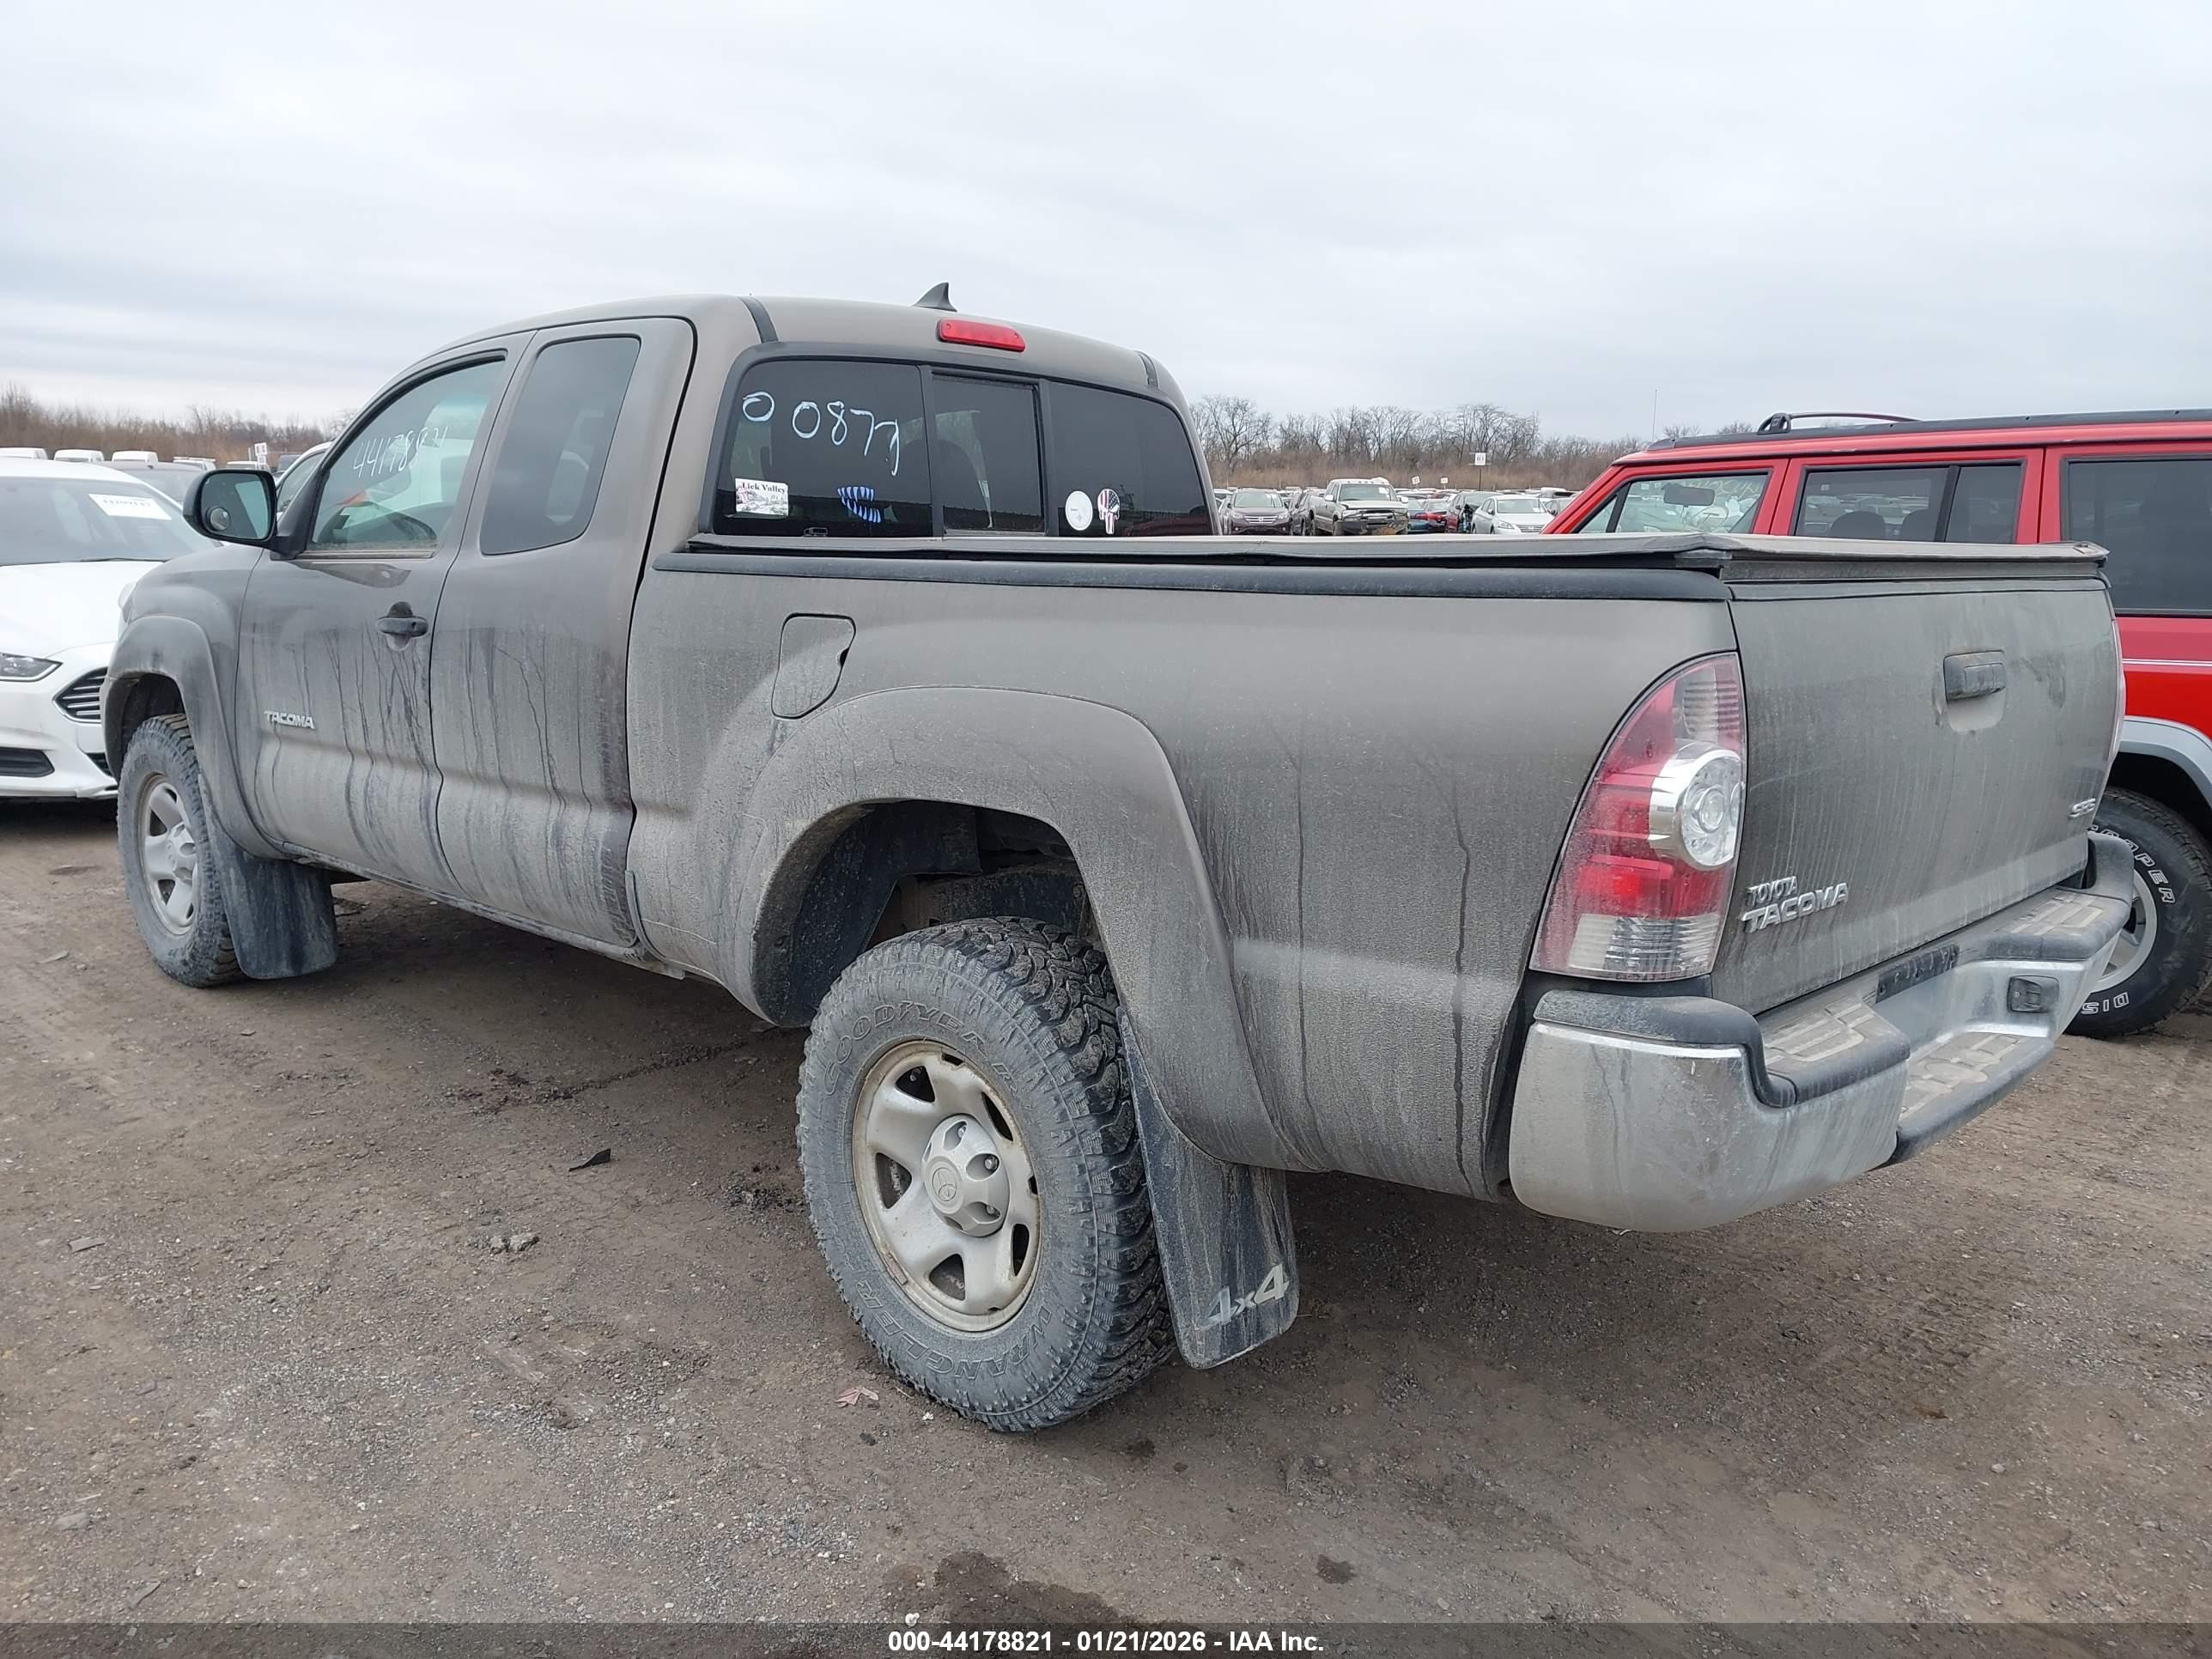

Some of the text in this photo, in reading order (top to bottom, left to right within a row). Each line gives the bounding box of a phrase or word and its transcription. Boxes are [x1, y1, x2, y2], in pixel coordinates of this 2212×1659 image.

[762, 484, 786, 494] Valley
[264, 710, 315, 730] TACOMA
[1741, 883, 1849, 933] TACOMA
[1747, 876, 1797, 907] TOYOTA
[824, 1000, 1018, 1095] GOODYEAR
[1202, 1263, 1290, 1326] 4x4
[856, 1279, 1052, 1380] WRANGLER
